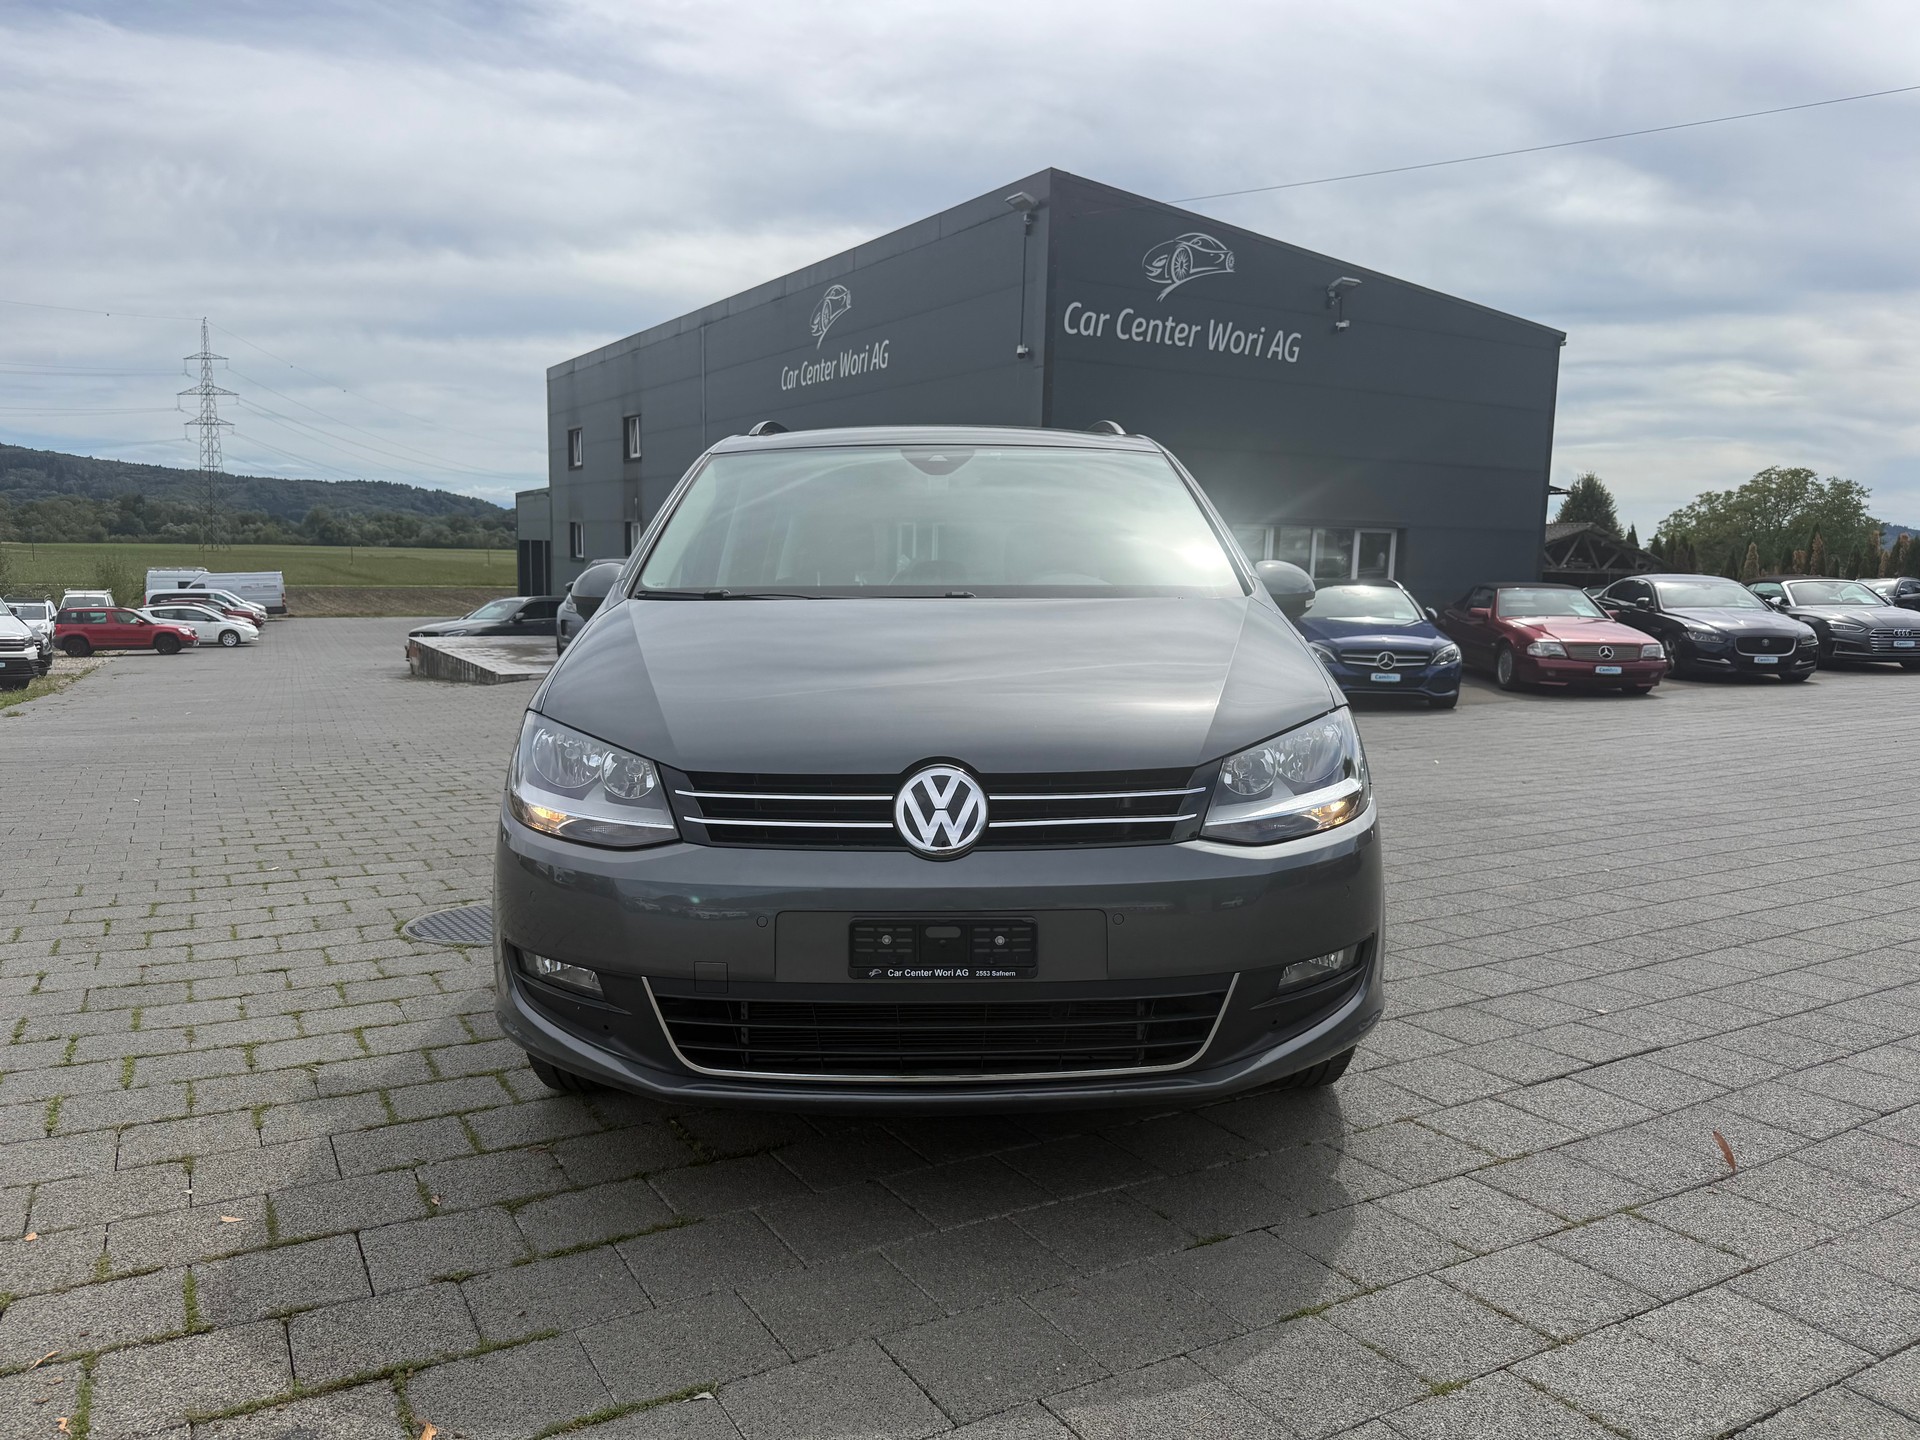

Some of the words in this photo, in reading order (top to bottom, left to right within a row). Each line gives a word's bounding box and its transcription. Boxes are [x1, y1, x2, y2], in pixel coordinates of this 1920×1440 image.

[1064, 302, 1110, 337] Car
[1116, 308, 1201, 347] Center
[1208, 319, 1265, 357] Wori
[1267, 330, 1302, 363] AG
[781, 366, 799, 391] Car
[801, 358, 837, 386] Center
[840, 345, 869, 378] Wori
[870, 339, 889, 371] AG
[887, 968, 903, 977] Car
[904, 968, 933, 977] Center
[934, 968, 954, 977] Wori
[955, 968, 969, 977] AG
[991, 969, 1016, 977] Safnern
